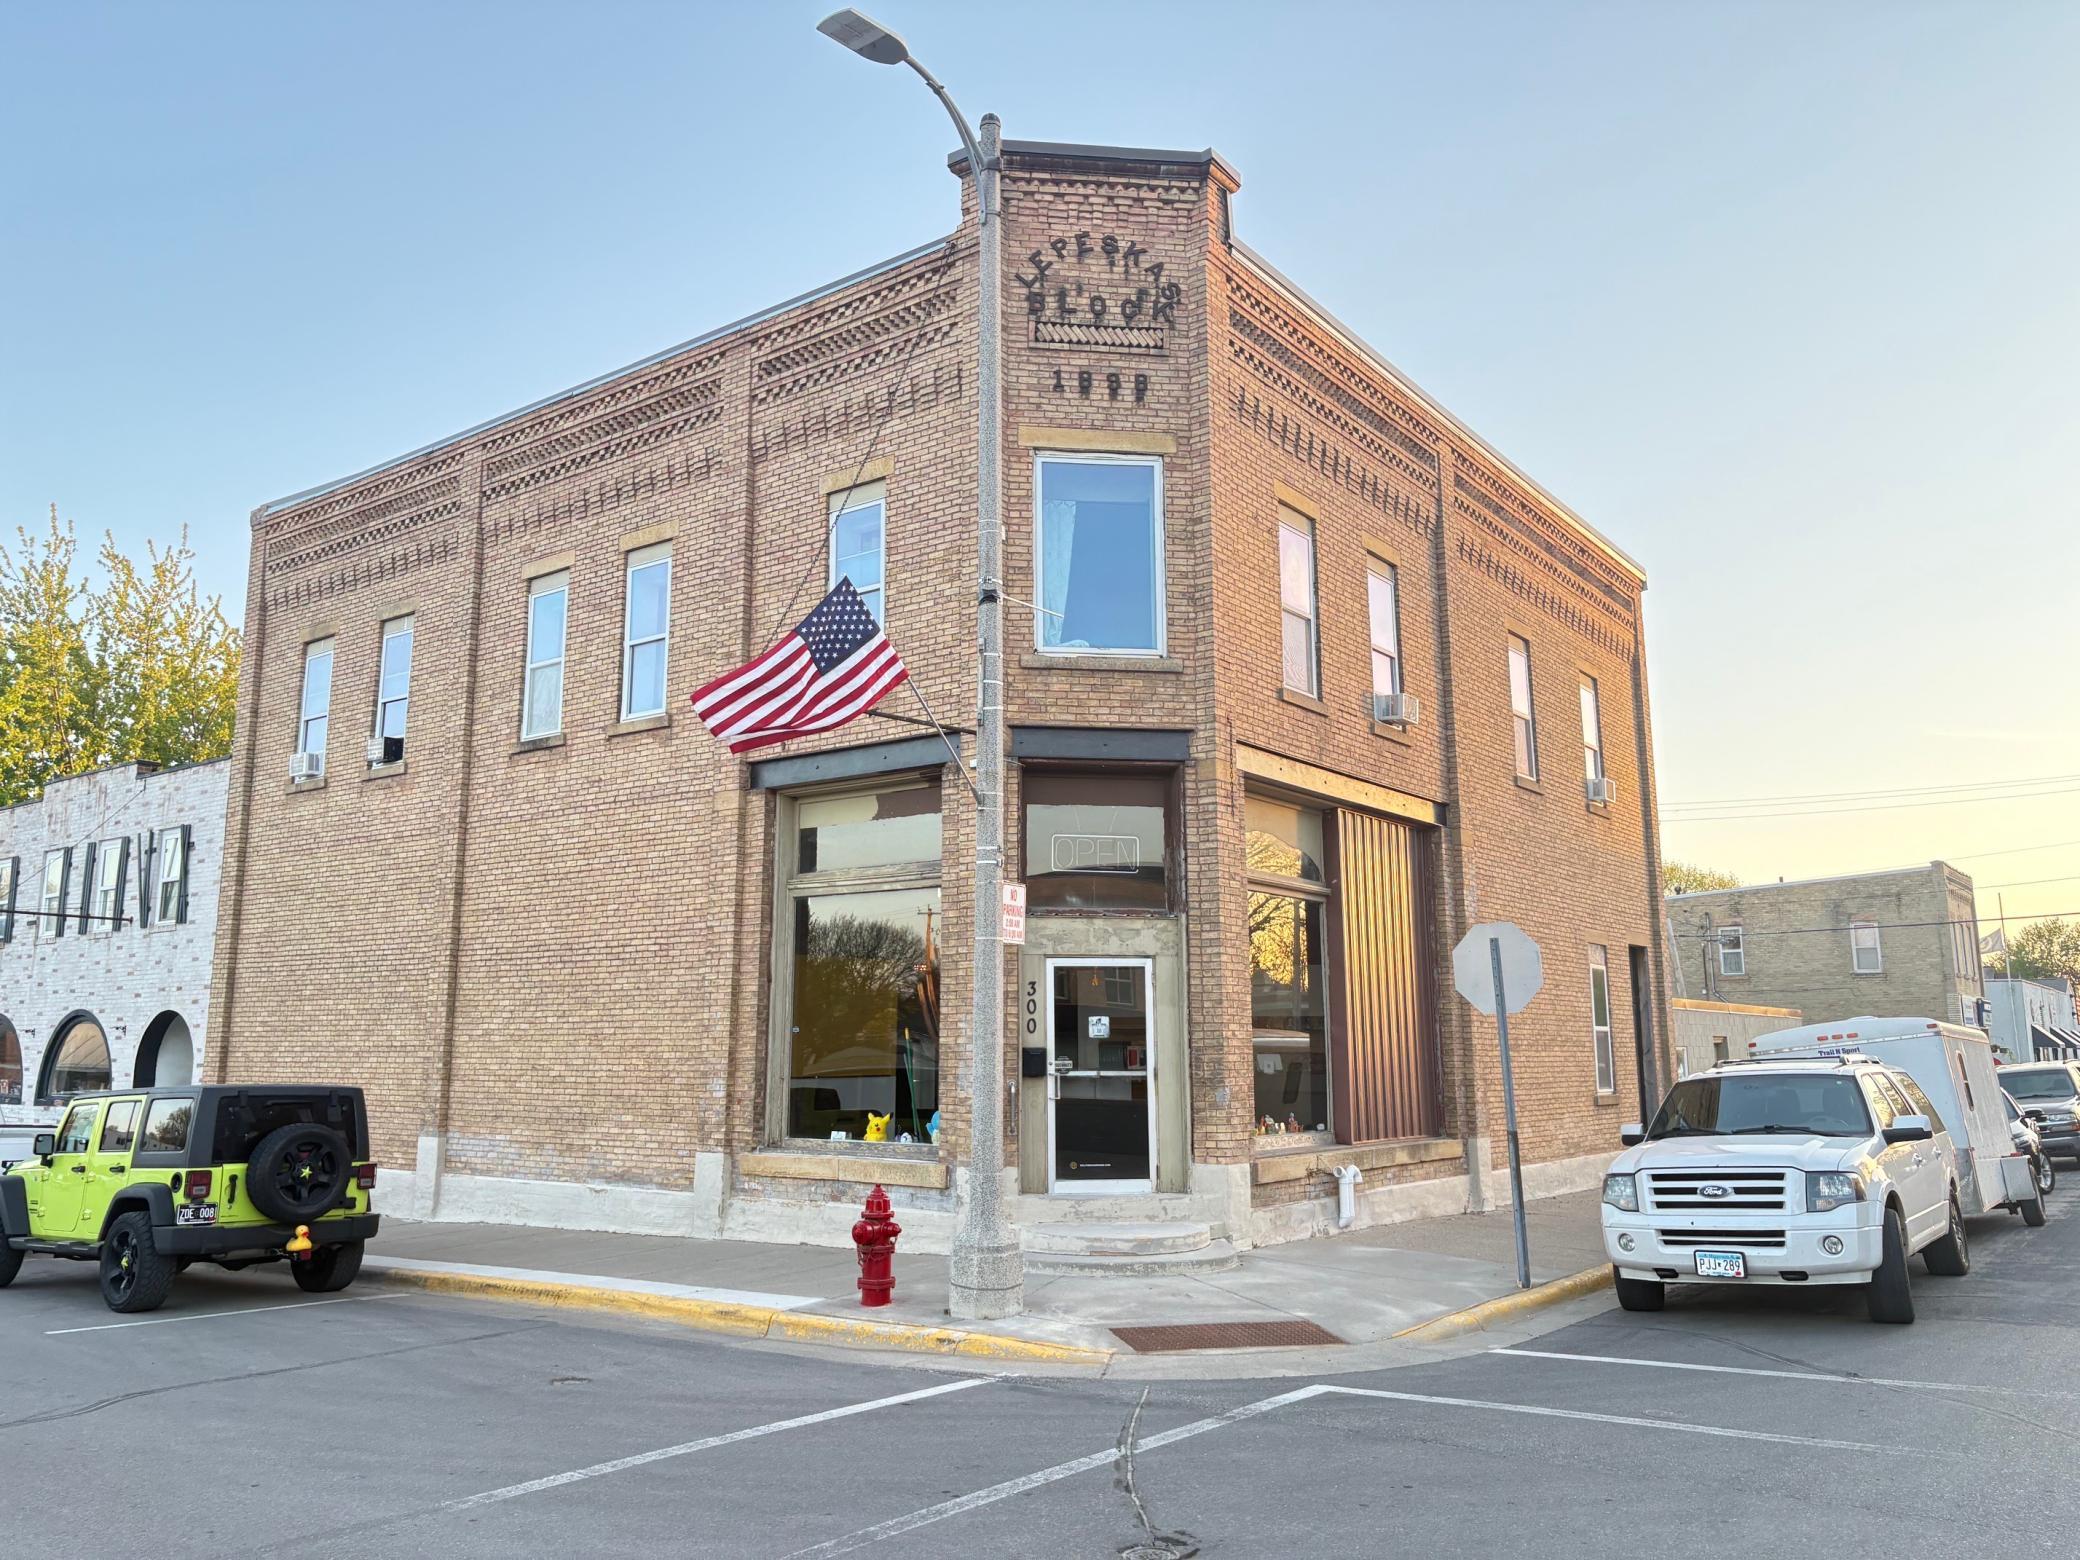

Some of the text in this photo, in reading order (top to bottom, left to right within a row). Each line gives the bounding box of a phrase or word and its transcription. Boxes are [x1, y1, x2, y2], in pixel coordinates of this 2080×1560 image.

[1015, 231, 1182, 301] LEPESKAS
[1027, 288, 1175, 322] BLOCK
[1055, 838, 1136, 871] OPEN
[1010, 888, 1018, 902] NO
[1002, 903, 1025, 918] PARKING
[1027, 981, 1037, 1034] 300
[1818, 1048, 1835, 1057] Trail
[1841, 1045, 1861, 1055] Sport
[1703, 1186, 1723, 1195] Ford
[199, 1207, 215, 1218] 008
[1699, 1258, 1741, 1272] PJJ 289
